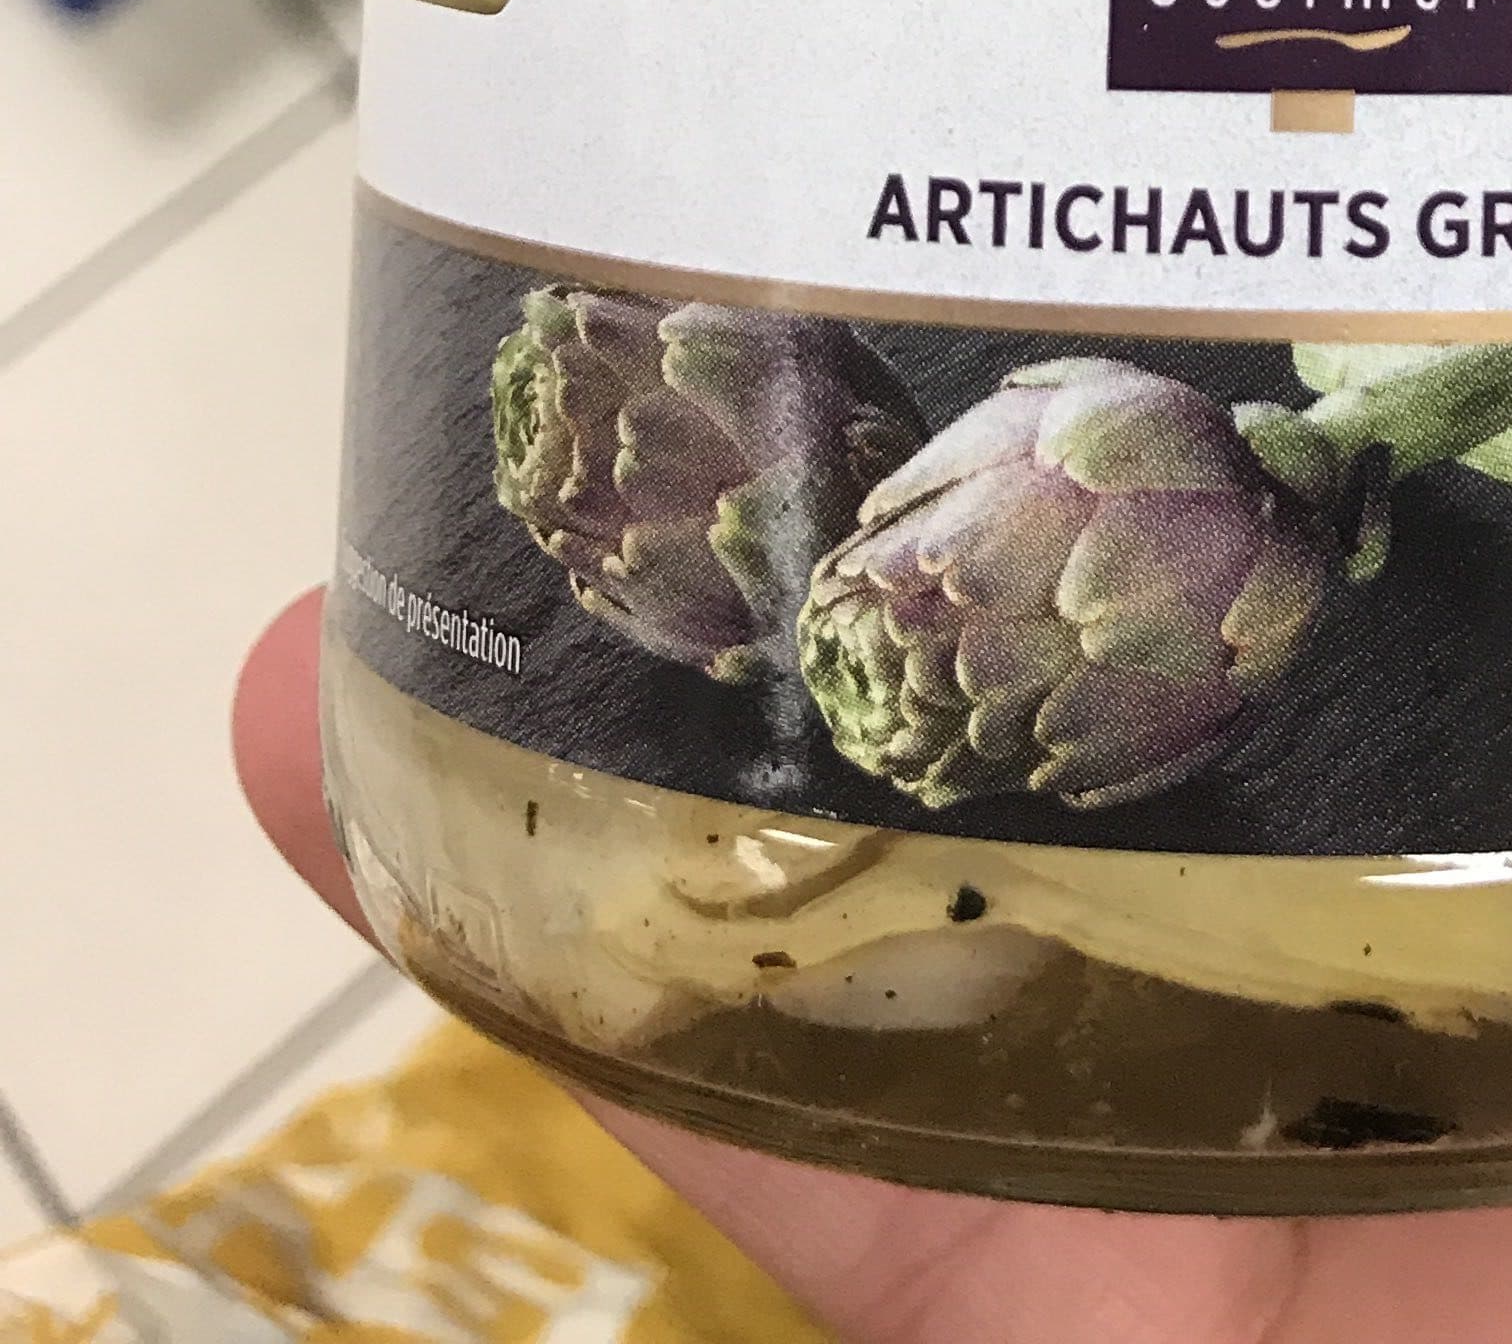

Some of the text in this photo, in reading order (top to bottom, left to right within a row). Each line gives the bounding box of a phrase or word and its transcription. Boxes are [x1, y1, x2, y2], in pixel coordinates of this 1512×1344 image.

[866, 172, 1392, 259] ARTICHAUTS
[387, 572, 406, 621] de
[406, 592, 521, 674] présentation
